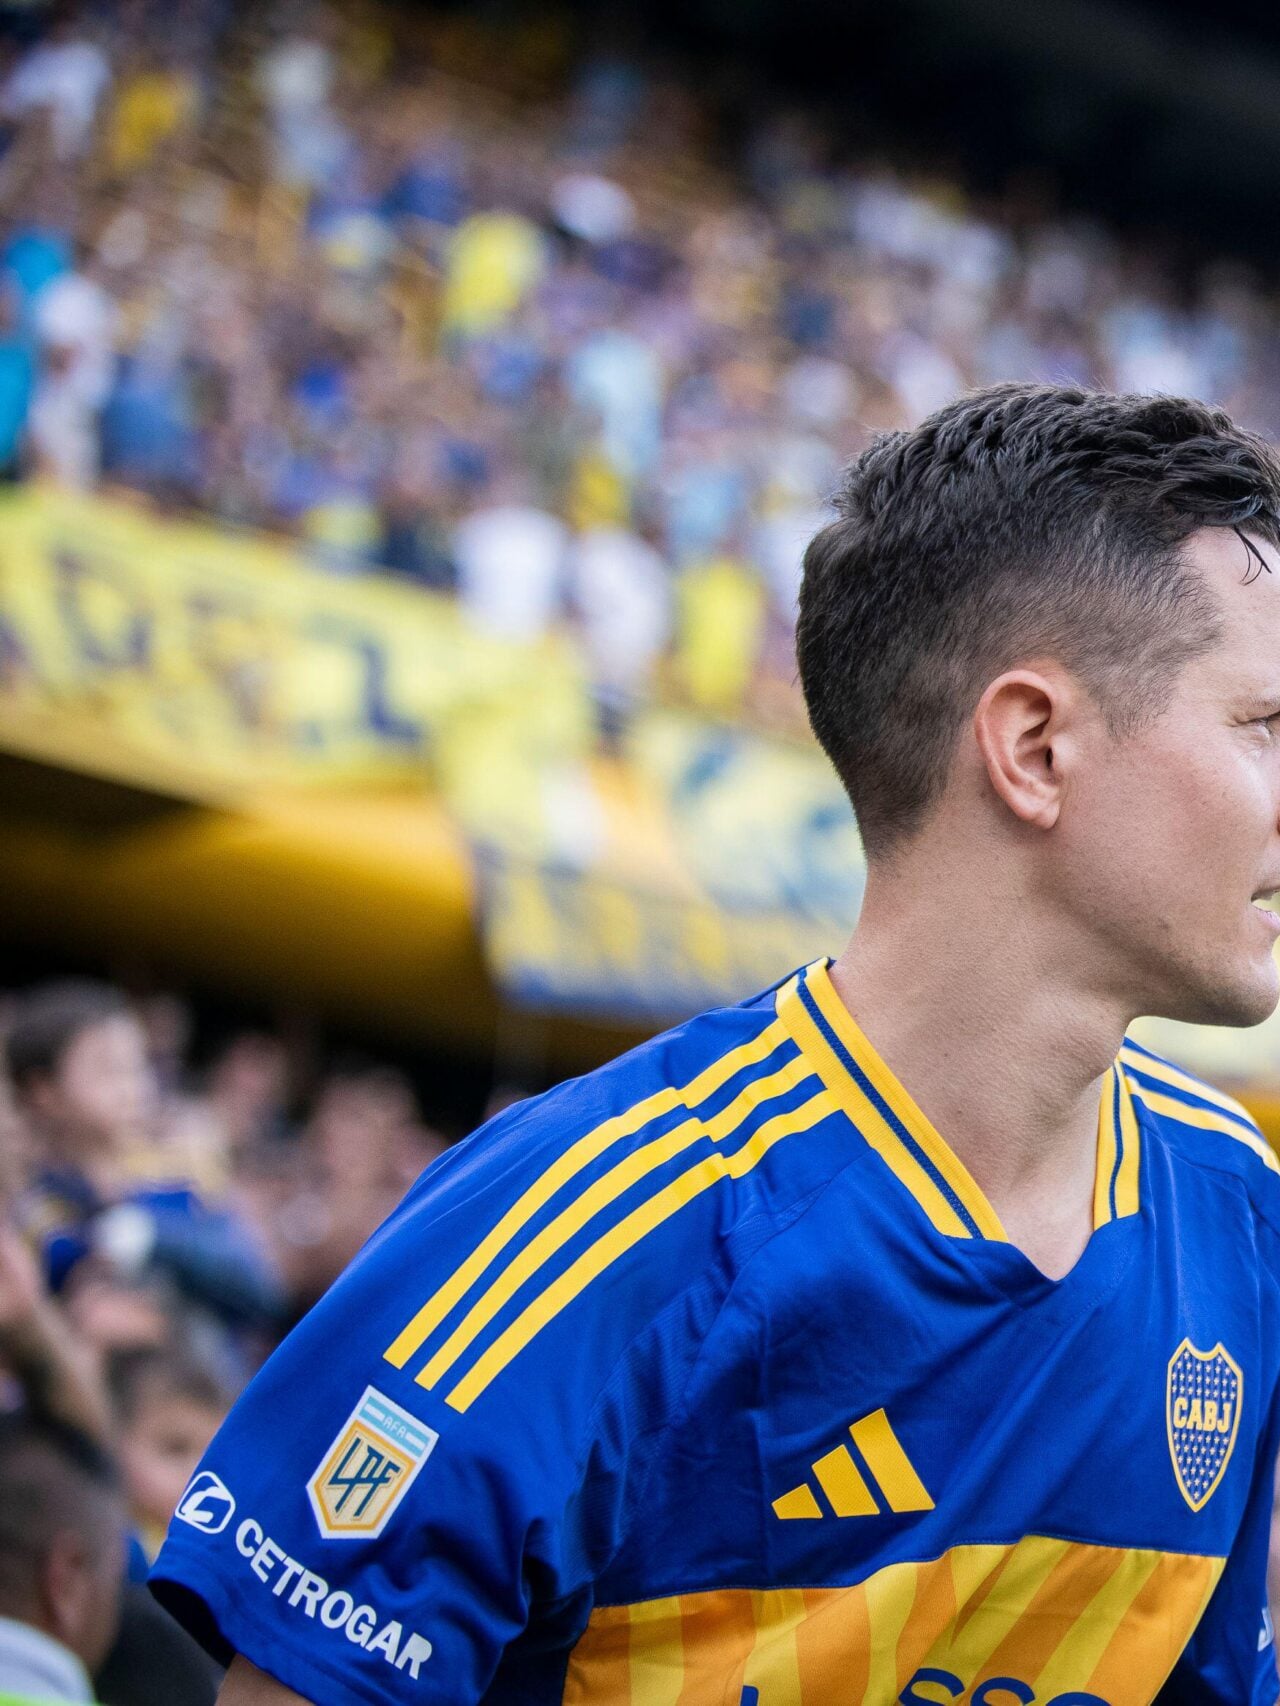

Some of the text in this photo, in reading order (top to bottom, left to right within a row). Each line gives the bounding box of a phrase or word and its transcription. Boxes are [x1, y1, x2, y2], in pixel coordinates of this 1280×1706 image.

[383, 1416, 408, 1438] AFA
[1173, 1396, 1232, 1433] CABJ
[235, 1518, 433, 1681] CETROGAR
